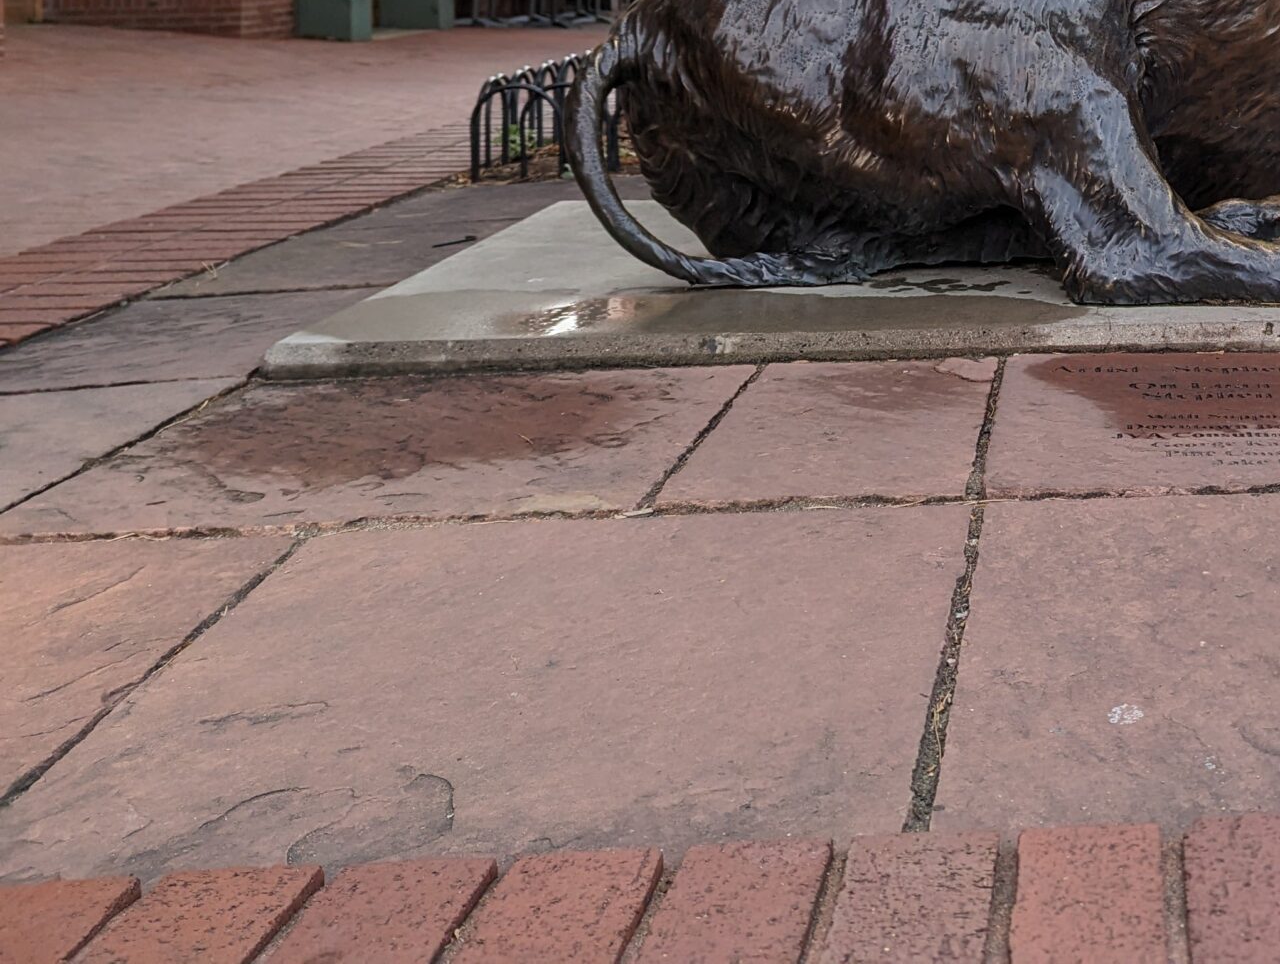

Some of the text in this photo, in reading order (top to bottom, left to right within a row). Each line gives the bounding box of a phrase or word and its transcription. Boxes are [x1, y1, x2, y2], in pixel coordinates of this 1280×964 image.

[1125, 423, 1248, 431] Downtown
[1111, 432, 1167, 440] JVA
[1150, 440, 1238, 449] George
